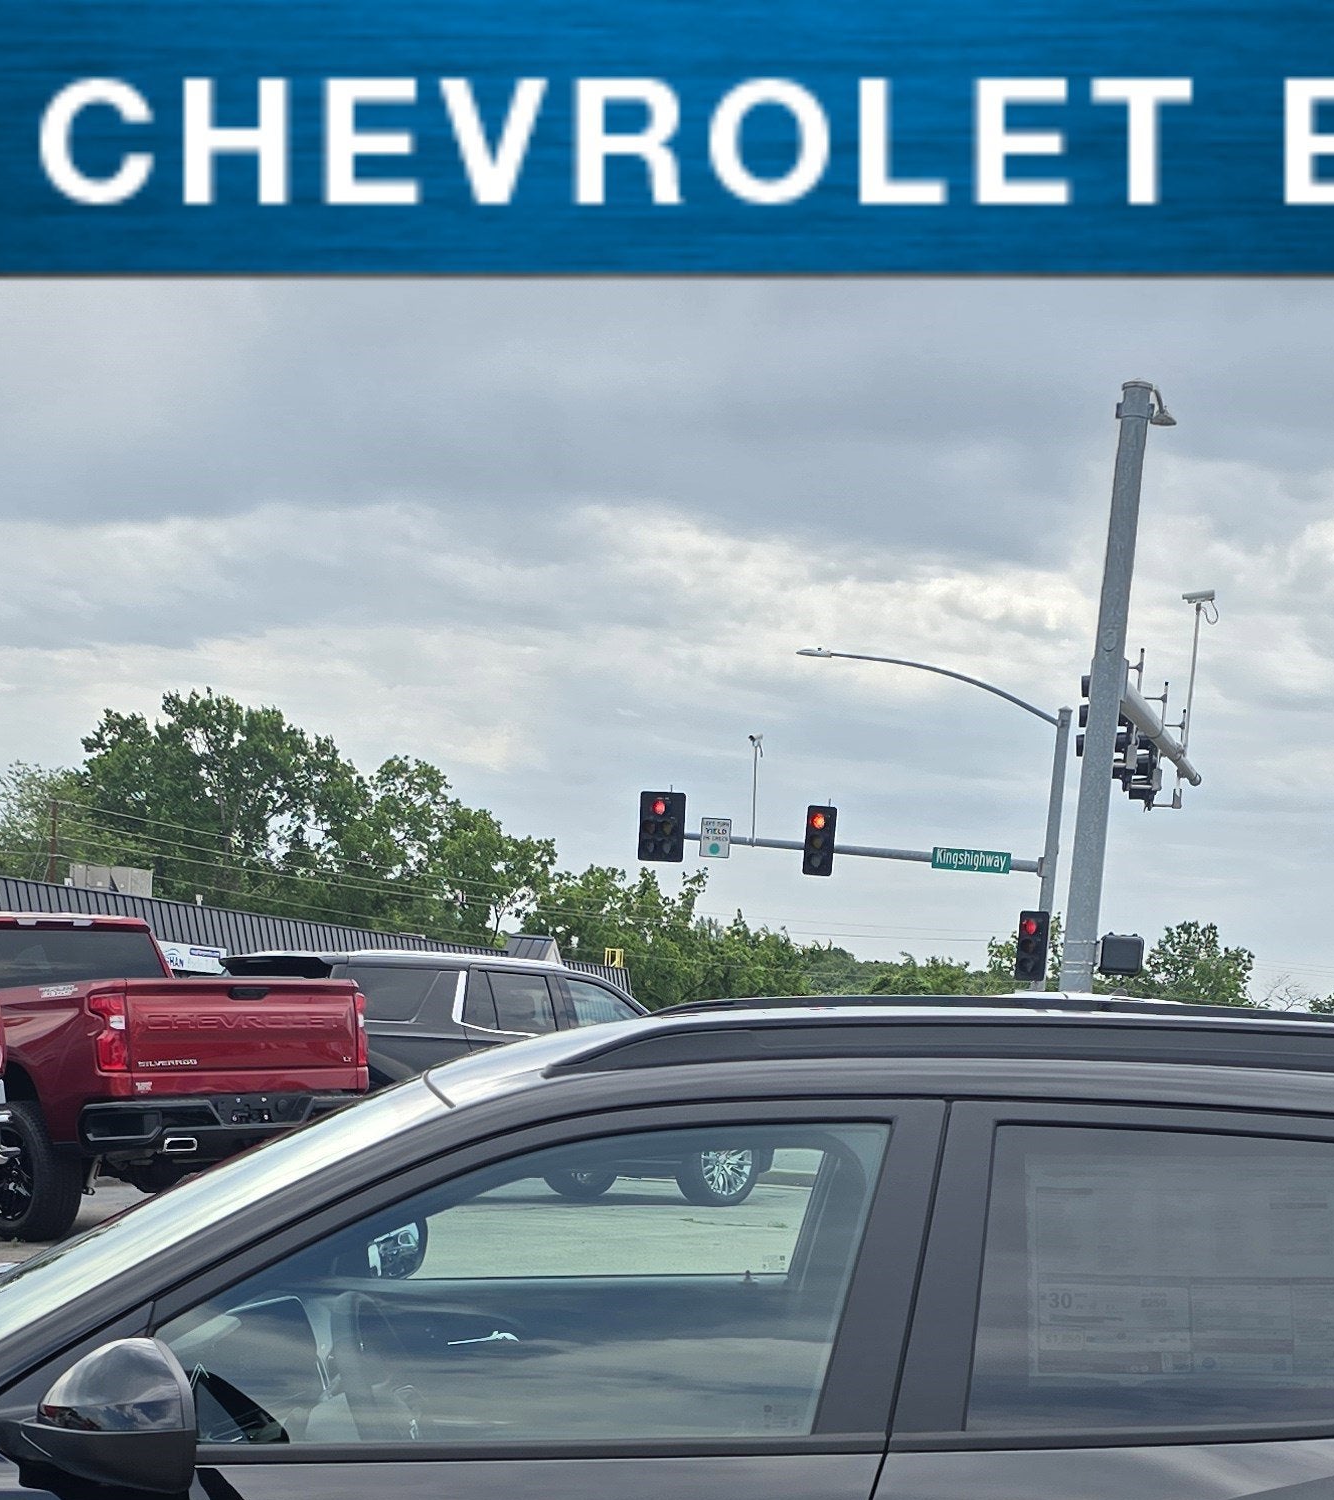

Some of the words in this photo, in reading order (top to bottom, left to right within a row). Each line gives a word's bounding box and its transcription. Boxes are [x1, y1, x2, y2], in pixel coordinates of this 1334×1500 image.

[936, 848, 1007, 871] Kingshighway
[147, 1013, 346, 1029] CHEVROLET
[137, 1059, 198, 1068] SILVERADO
